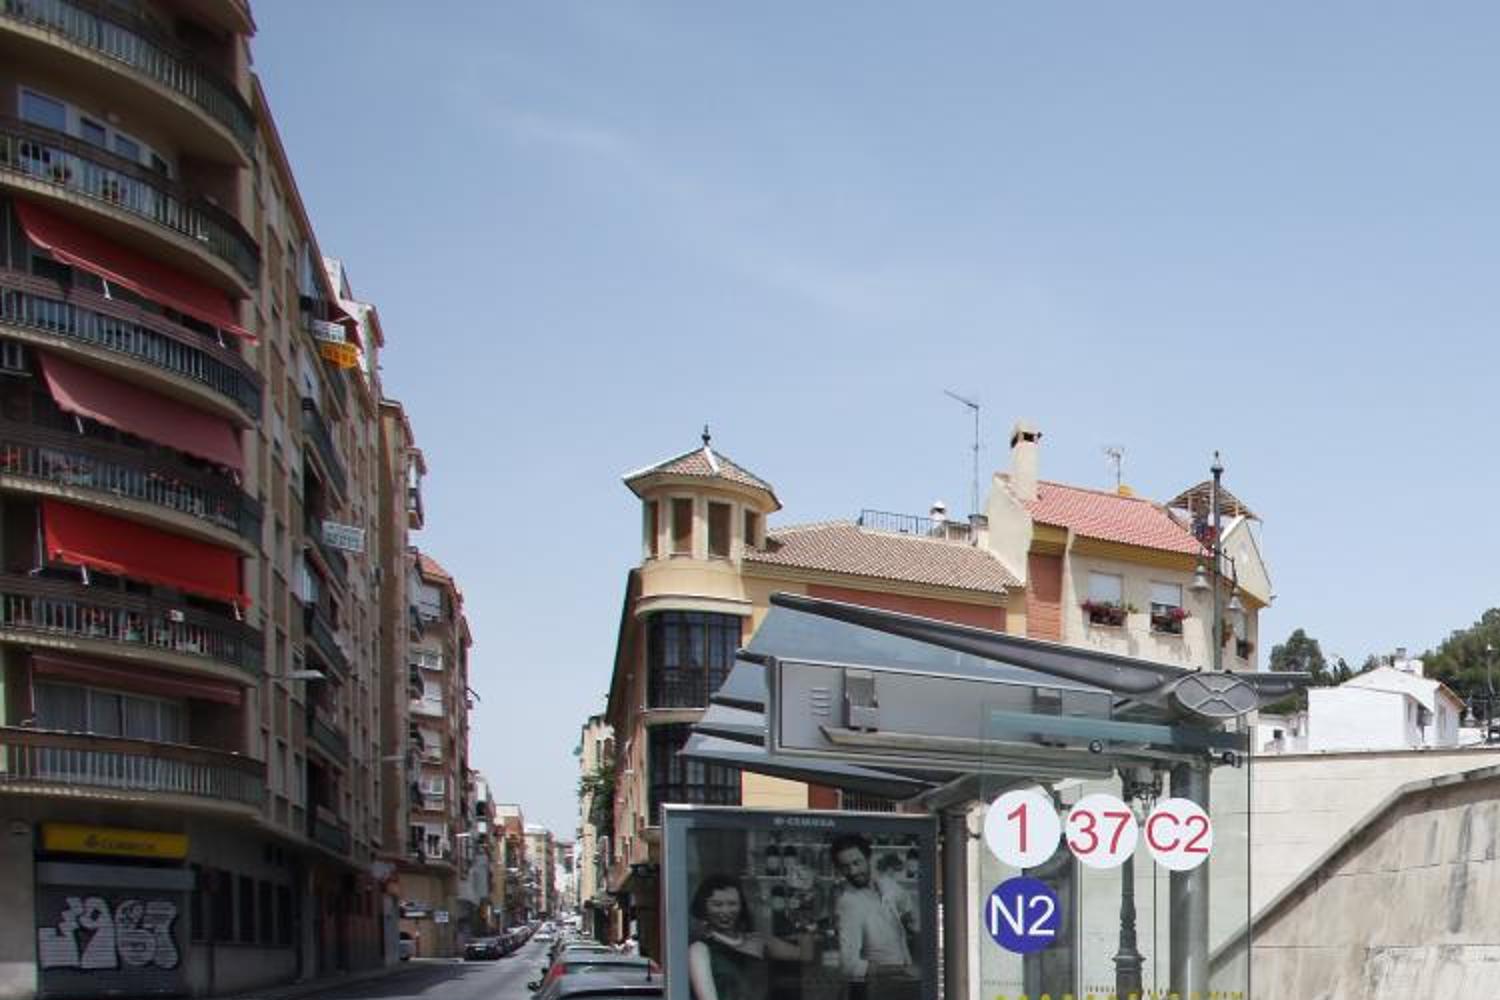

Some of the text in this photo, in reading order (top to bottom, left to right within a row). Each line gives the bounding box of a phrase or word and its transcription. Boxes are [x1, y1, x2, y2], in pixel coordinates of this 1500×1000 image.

[1007, 803, 1028, 853] 1
[1069, 810, 1132, 855] 37
[1146, 812, 1209, 854] C2
[990, 895, 1055, 936] N2
